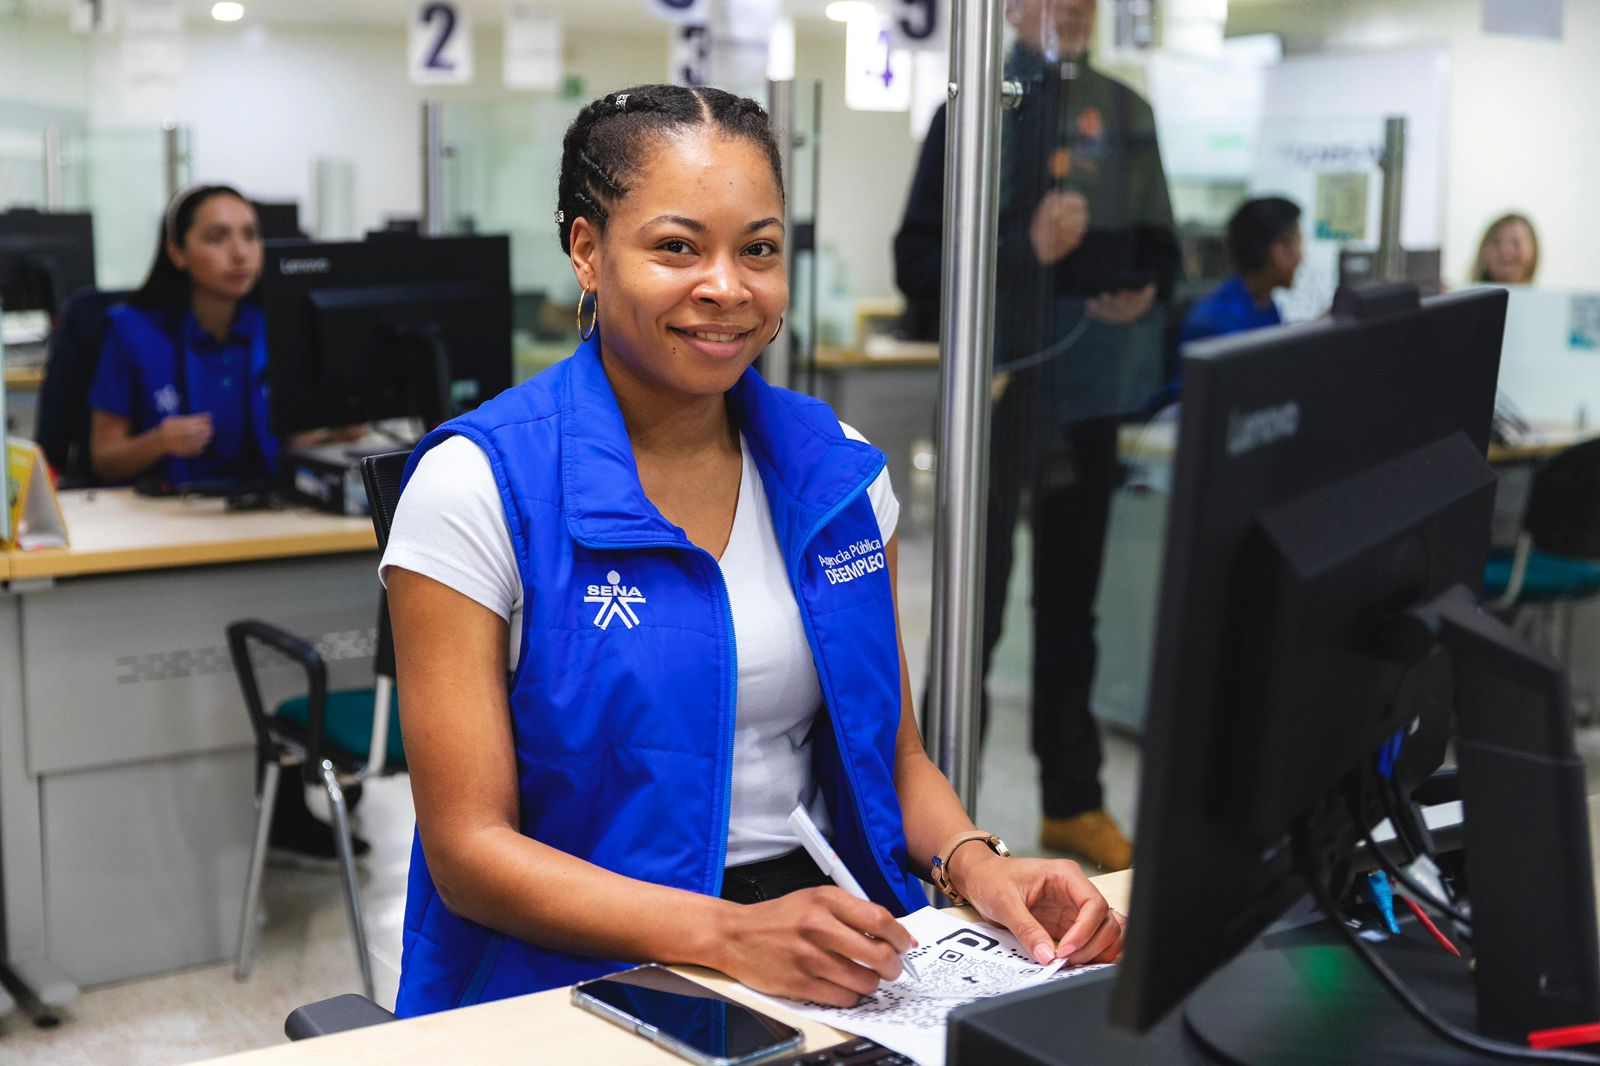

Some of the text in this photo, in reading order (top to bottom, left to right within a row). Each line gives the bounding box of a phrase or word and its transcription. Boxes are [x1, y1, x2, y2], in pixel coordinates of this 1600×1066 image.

[420, 2, 457, 70] 2
[279, 257, 330, 275] Lenovo
[1226, 401, 1300, 456] Lenovo
[817, 538, 882, 569] Agencia Pública
[586, 584, 643, 598] SENA
